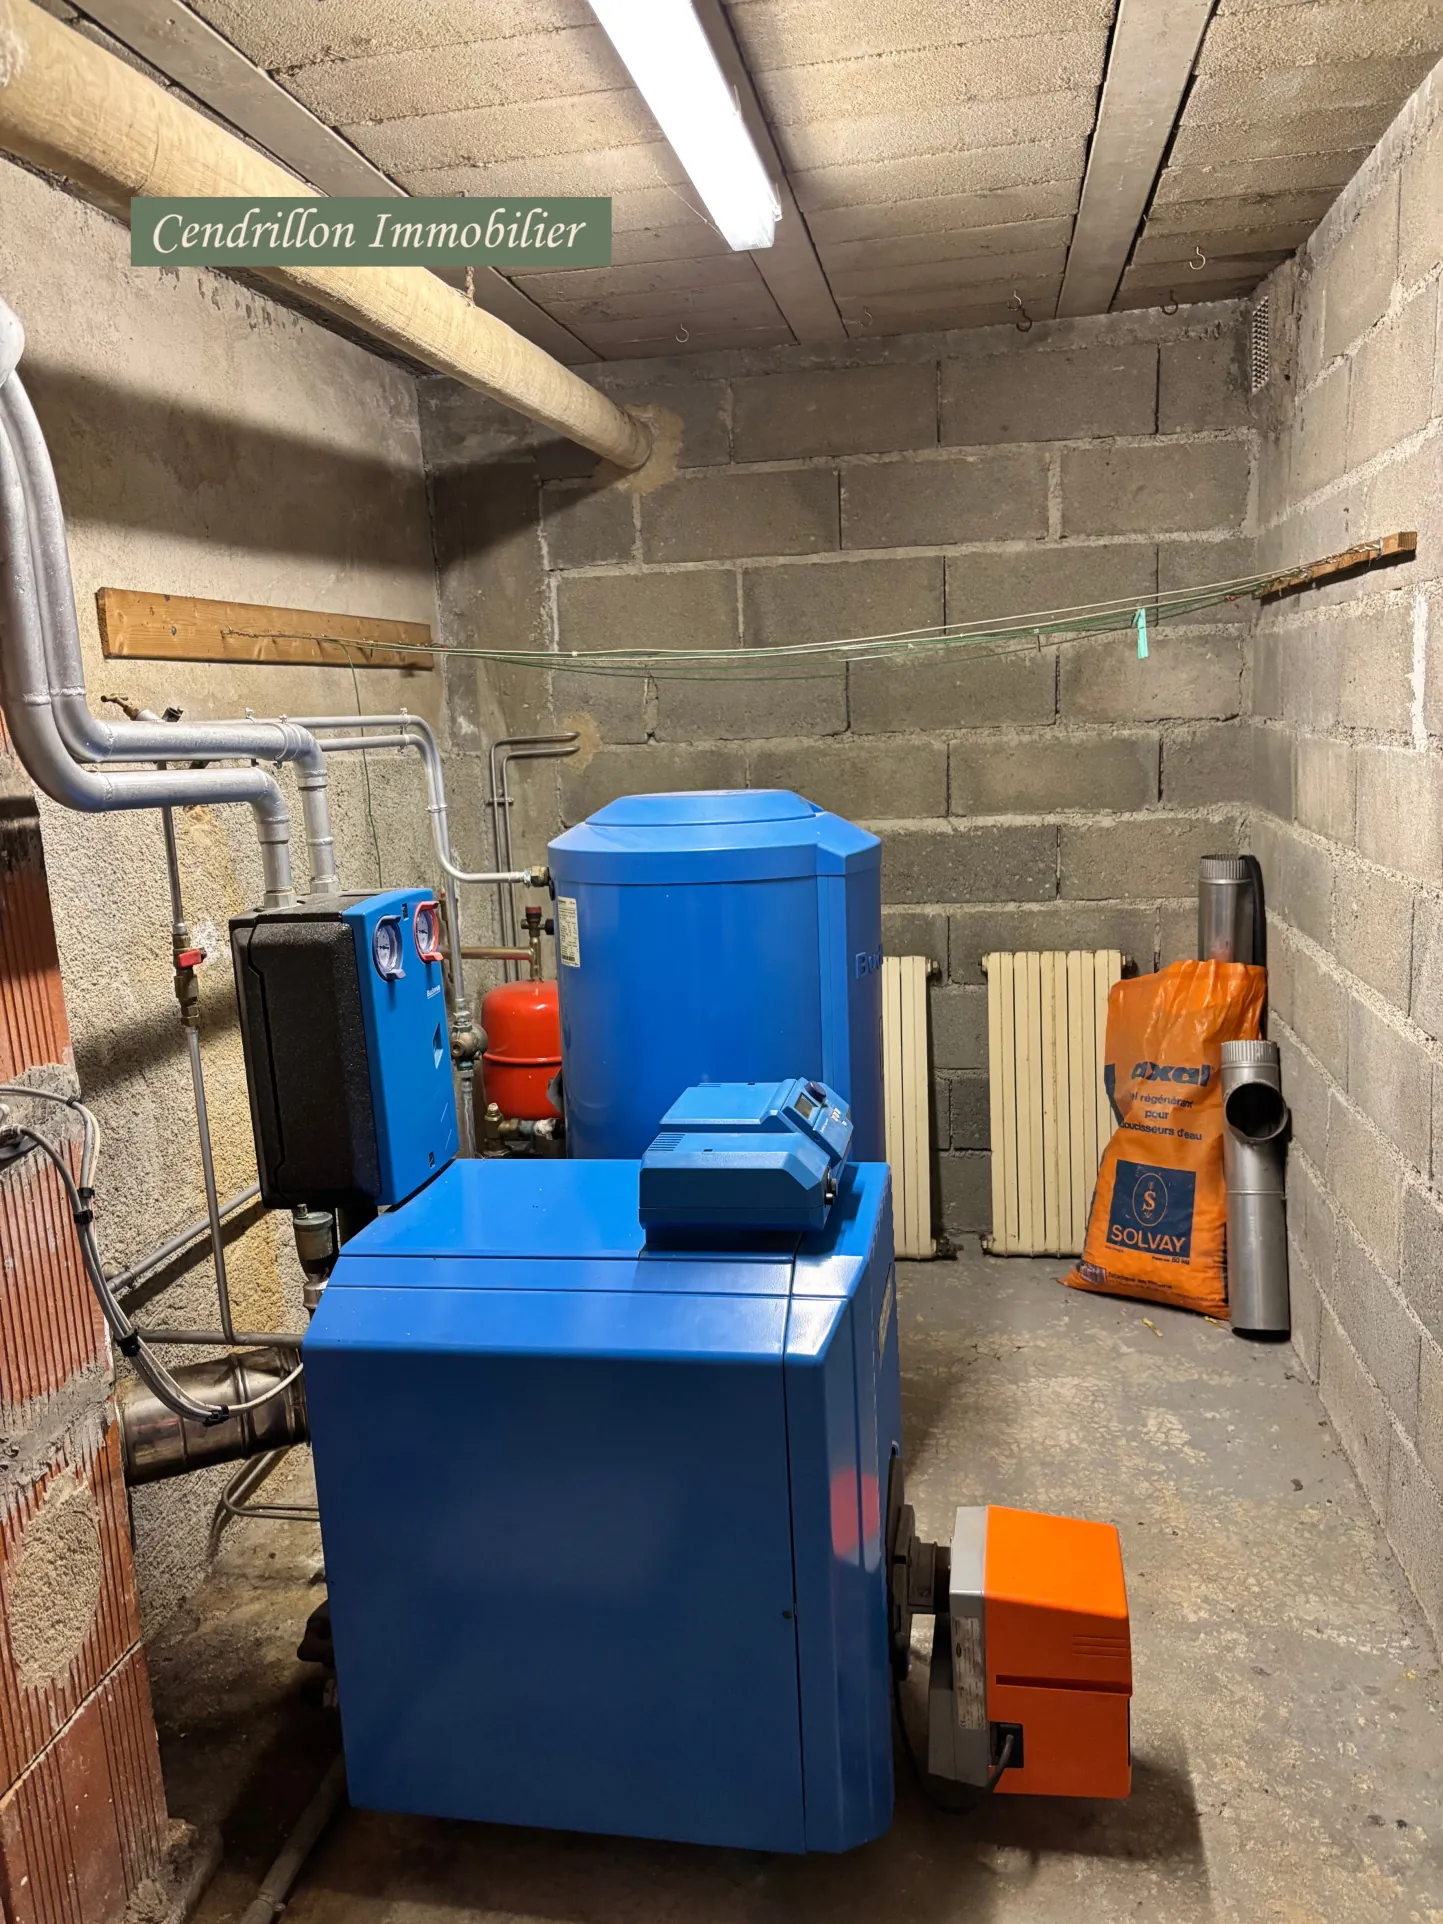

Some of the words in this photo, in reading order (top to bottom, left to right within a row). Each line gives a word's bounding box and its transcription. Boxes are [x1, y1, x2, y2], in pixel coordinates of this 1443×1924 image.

[1131, 1061, 1211, 1087] axal
[1144, 1109, 1170, 1119] pour
[1119, 1121, 1175, 1136] doucisseurs
[1176, 1127, 1203, 1141] d'eau
[1111, 1224, 1186, 1253] SOLVAY
